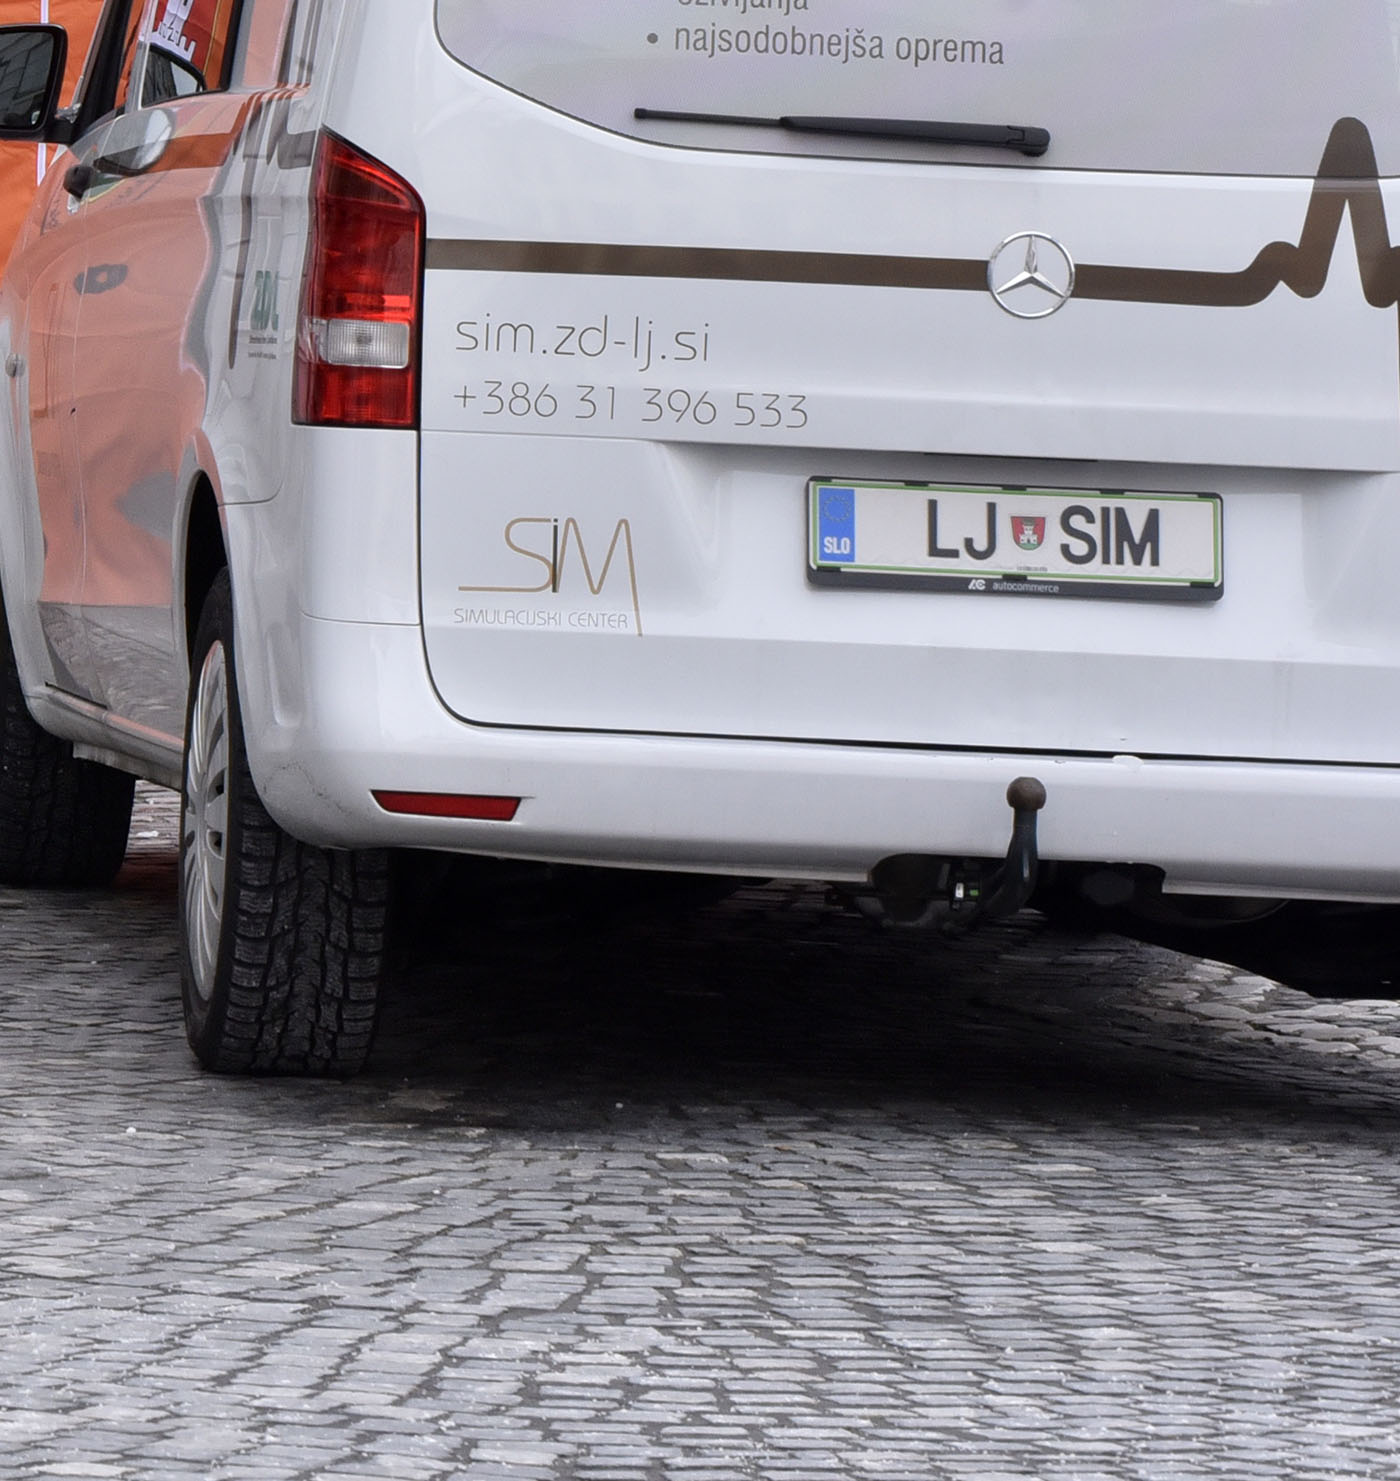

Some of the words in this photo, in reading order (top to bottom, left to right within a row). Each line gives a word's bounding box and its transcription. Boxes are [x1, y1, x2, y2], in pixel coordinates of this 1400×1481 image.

[674, 22, 884, 64] najsodobnejša
[895, 35, 1005, 68] oprema
[455, 312, 711, 373] sim.zd-lj.si
[453, 380, 558, 418] +386
[575, 384, 616, 420] 31
[641, 387, 717, 425] 396
[733, 392, 808, 429] 533
[823, 536, 851, 555] SLO
[926, 498, 998, 561] LJ
[1059, 504, 1161, 568] SIM
[992, 580, 1060, 594] autocommerce
[567, 611, 629, 629] CENTER
